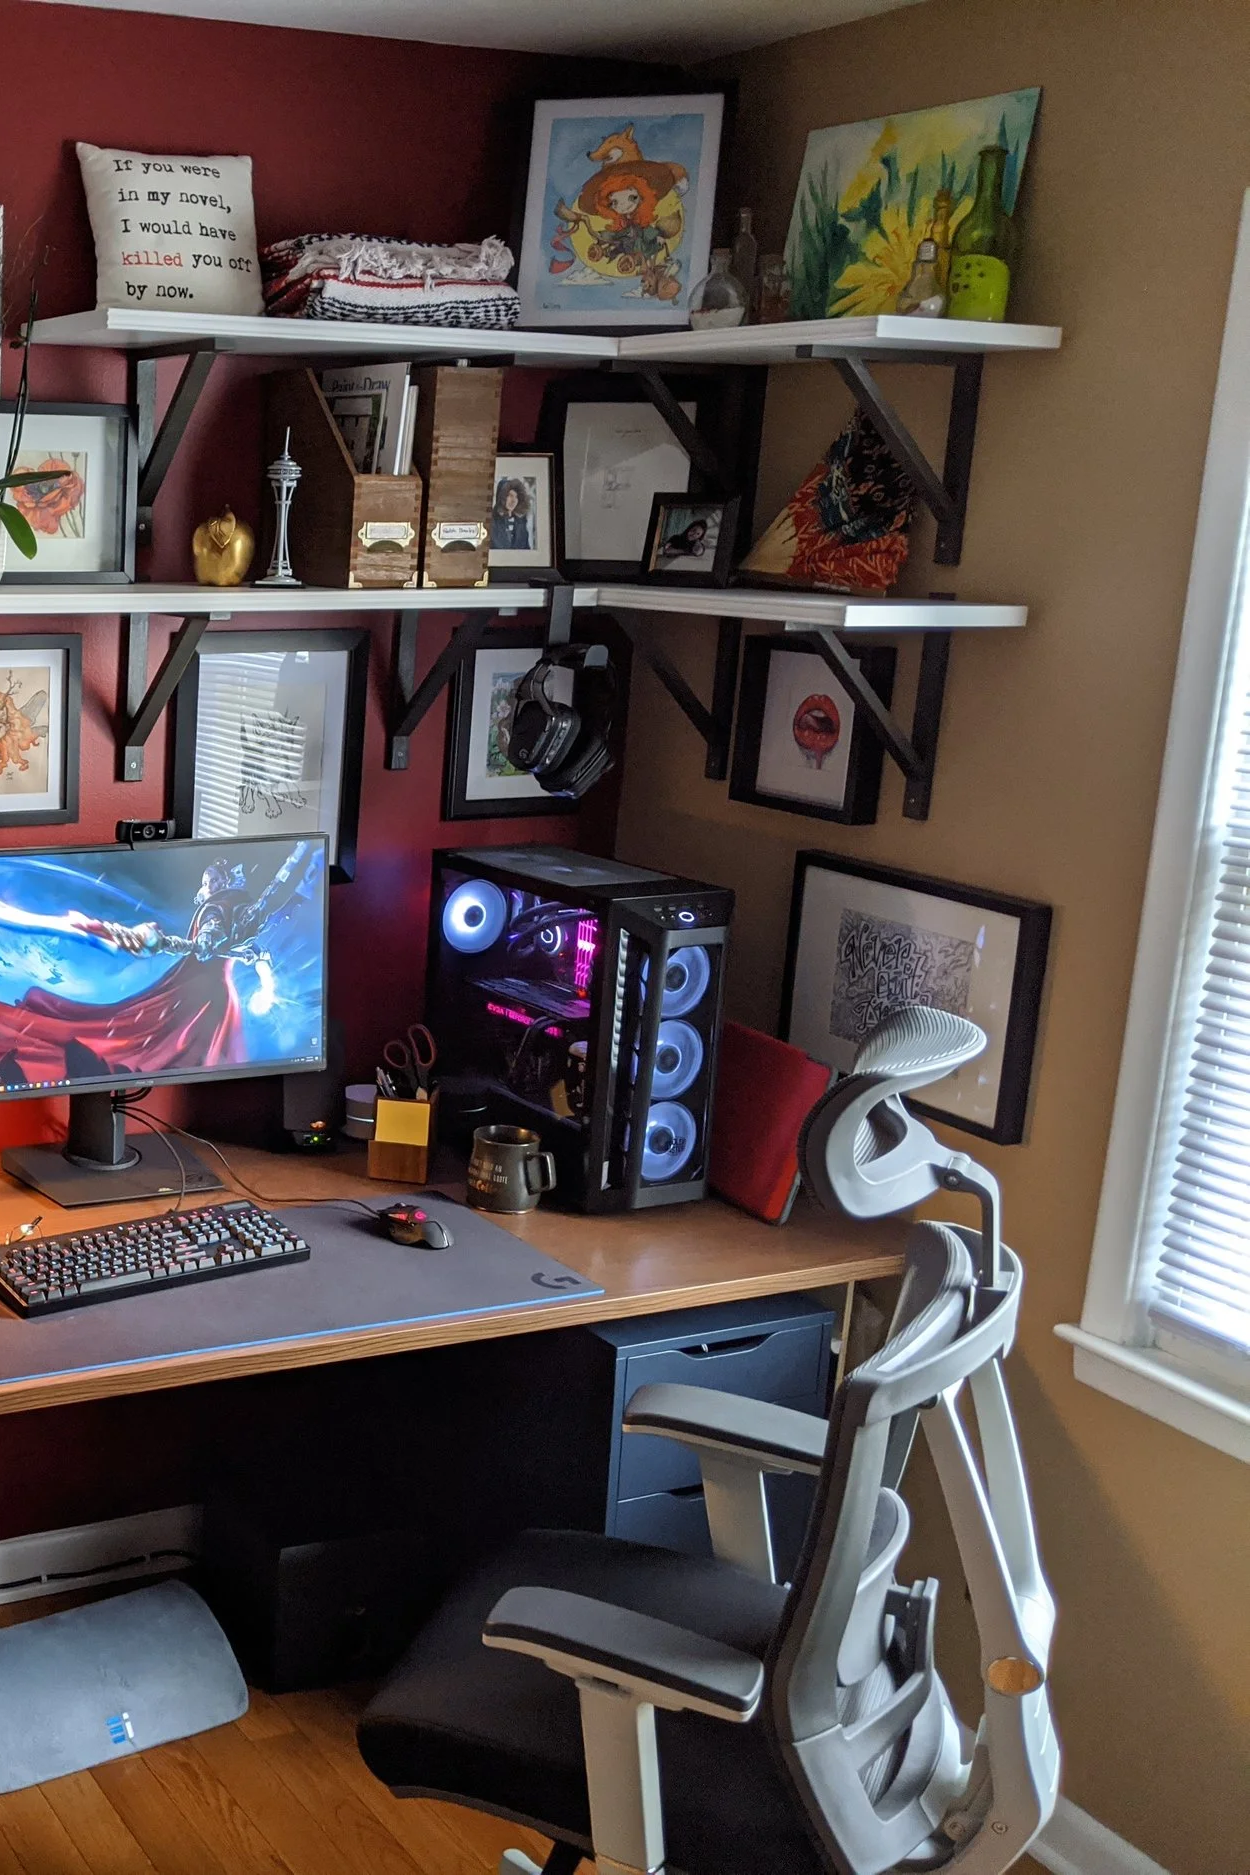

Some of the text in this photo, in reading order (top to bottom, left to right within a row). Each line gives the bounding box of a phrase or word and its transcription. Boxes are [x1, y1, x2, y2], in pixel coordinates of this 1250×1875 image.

[113, 159, 221, 179] If you were
[118, 188, 232, 214] in my novel,
[120, 219, 237, 241] I would have
[121, 251, 253, 273] killed you off
[125, 282, 194, 301] by now.
[363, 377, 391, 392] Draw
